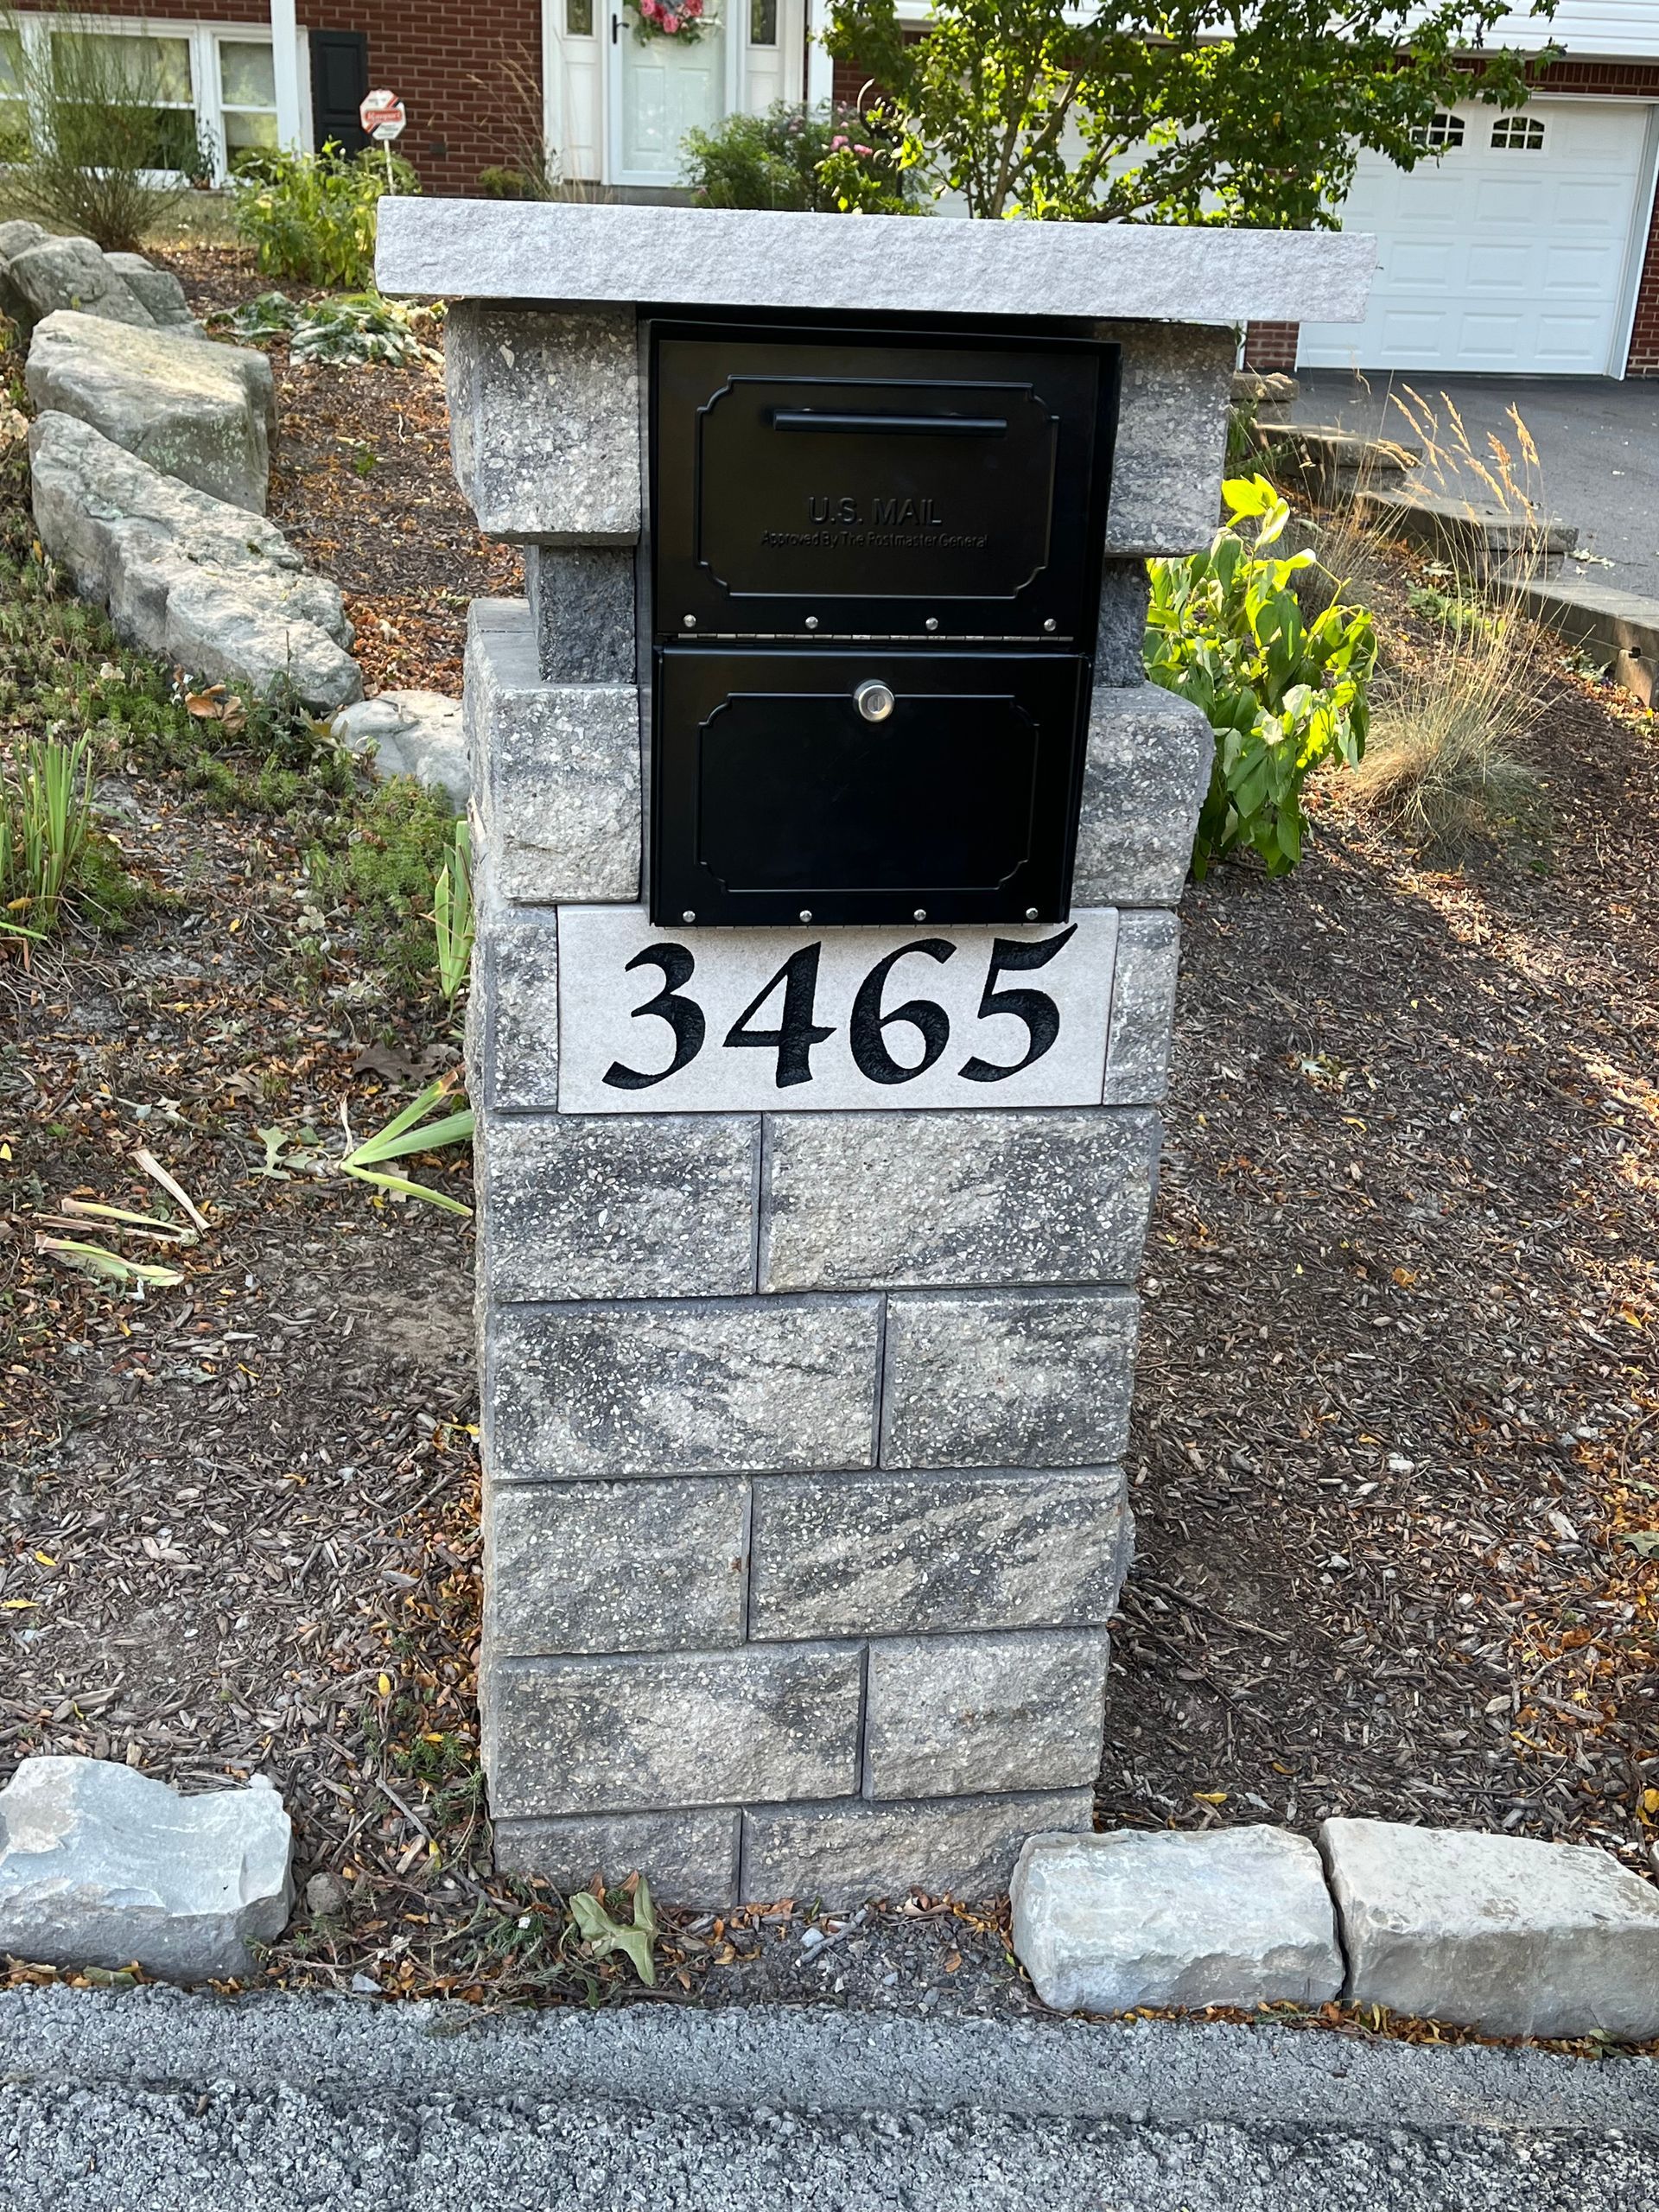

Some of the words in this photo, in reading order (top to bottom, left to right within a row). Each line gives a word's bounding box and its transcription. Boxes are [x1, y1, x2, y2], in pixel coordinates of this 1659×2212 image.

[808, 496, 863, 524] U.S.
[871, 498, 943, 526] MAIL
[760, 530, 820, 549] Approved
[822, 531, 838, 549] By
[841, 531, 864, 547] The
[867, 531, 939, 548] Postmaster
[940, 532, 989, 549] General
[601, 923, 1078, 1090] 3465
